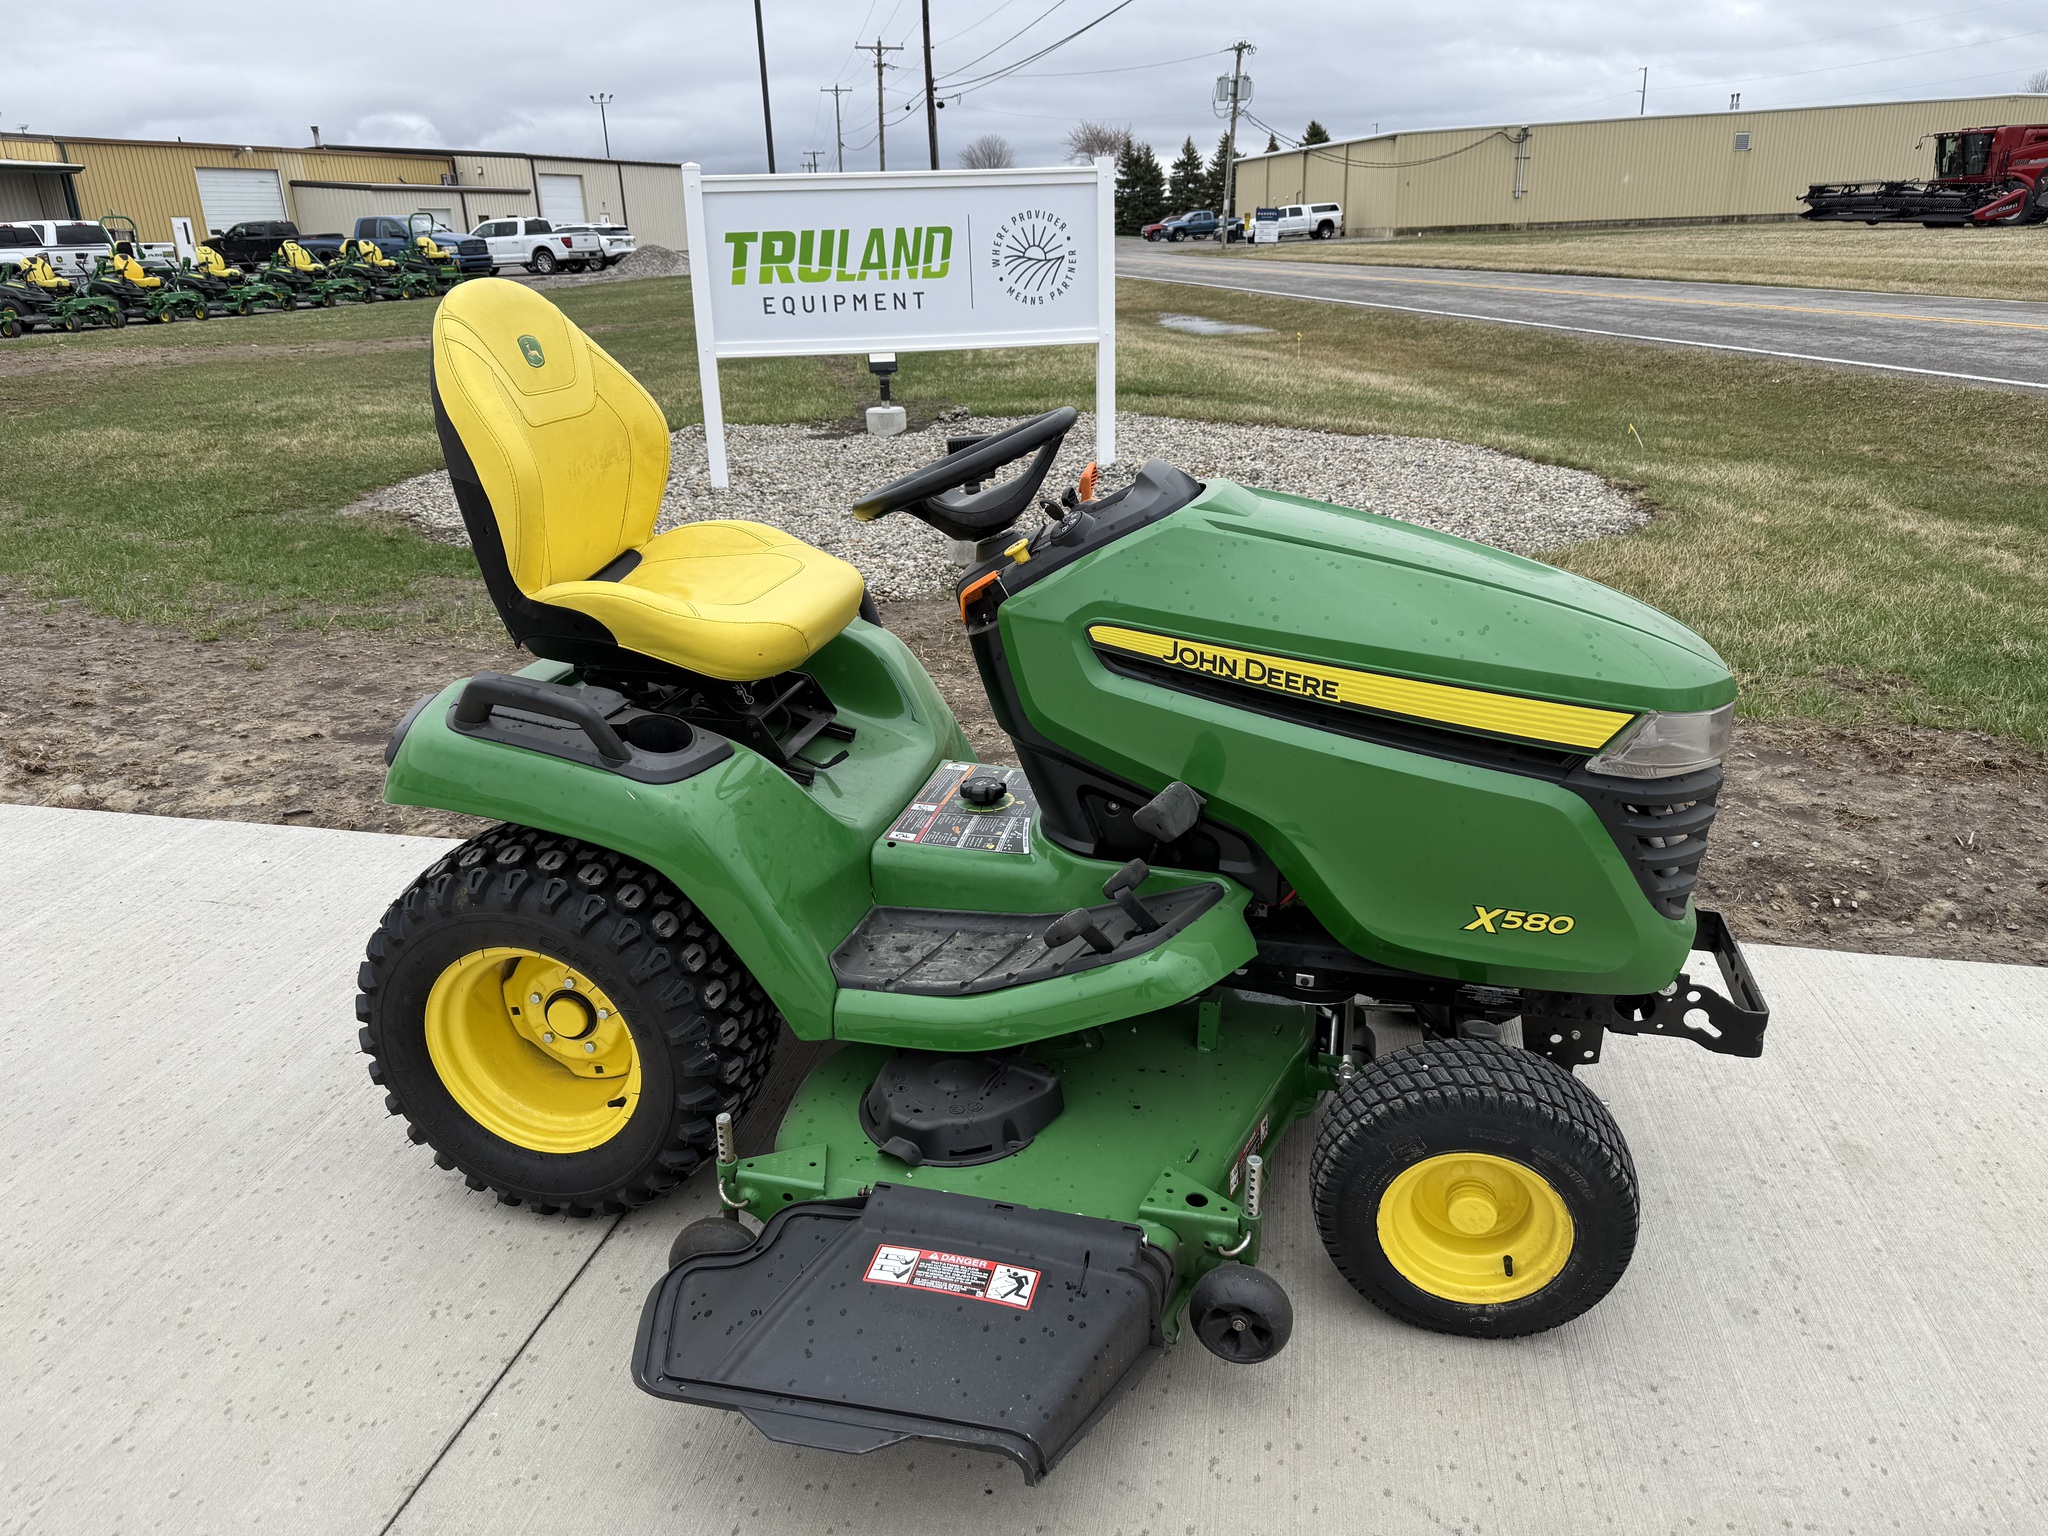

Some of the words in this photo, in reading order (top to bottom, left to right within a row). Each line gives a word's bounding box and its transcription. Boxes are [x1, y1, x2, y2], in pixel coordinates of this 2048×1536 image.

[724, 225, 953, 286] TRULAND
[991, 225, 1009, 268] WHERE
[1011, 209, 1067, 232] PROVIDER
[762, 291, 926, 316] EQUIPMENT
[1006, 286, 1044, 306] MEANS
[1049, 249, 1077, 301] PARTNER
[1162, 640, 1239, 678] JOHN
[1244, 657, 1340, 701] DEERE
[1460, 904, 1576, 936] X580
[538, 934, 652, 1041] CARLSTAR
[941, 1253, 988, 1268] DANGER
[881, 1301, 903, 1314] DO
[906, 1306, 939, 1320] NOT
